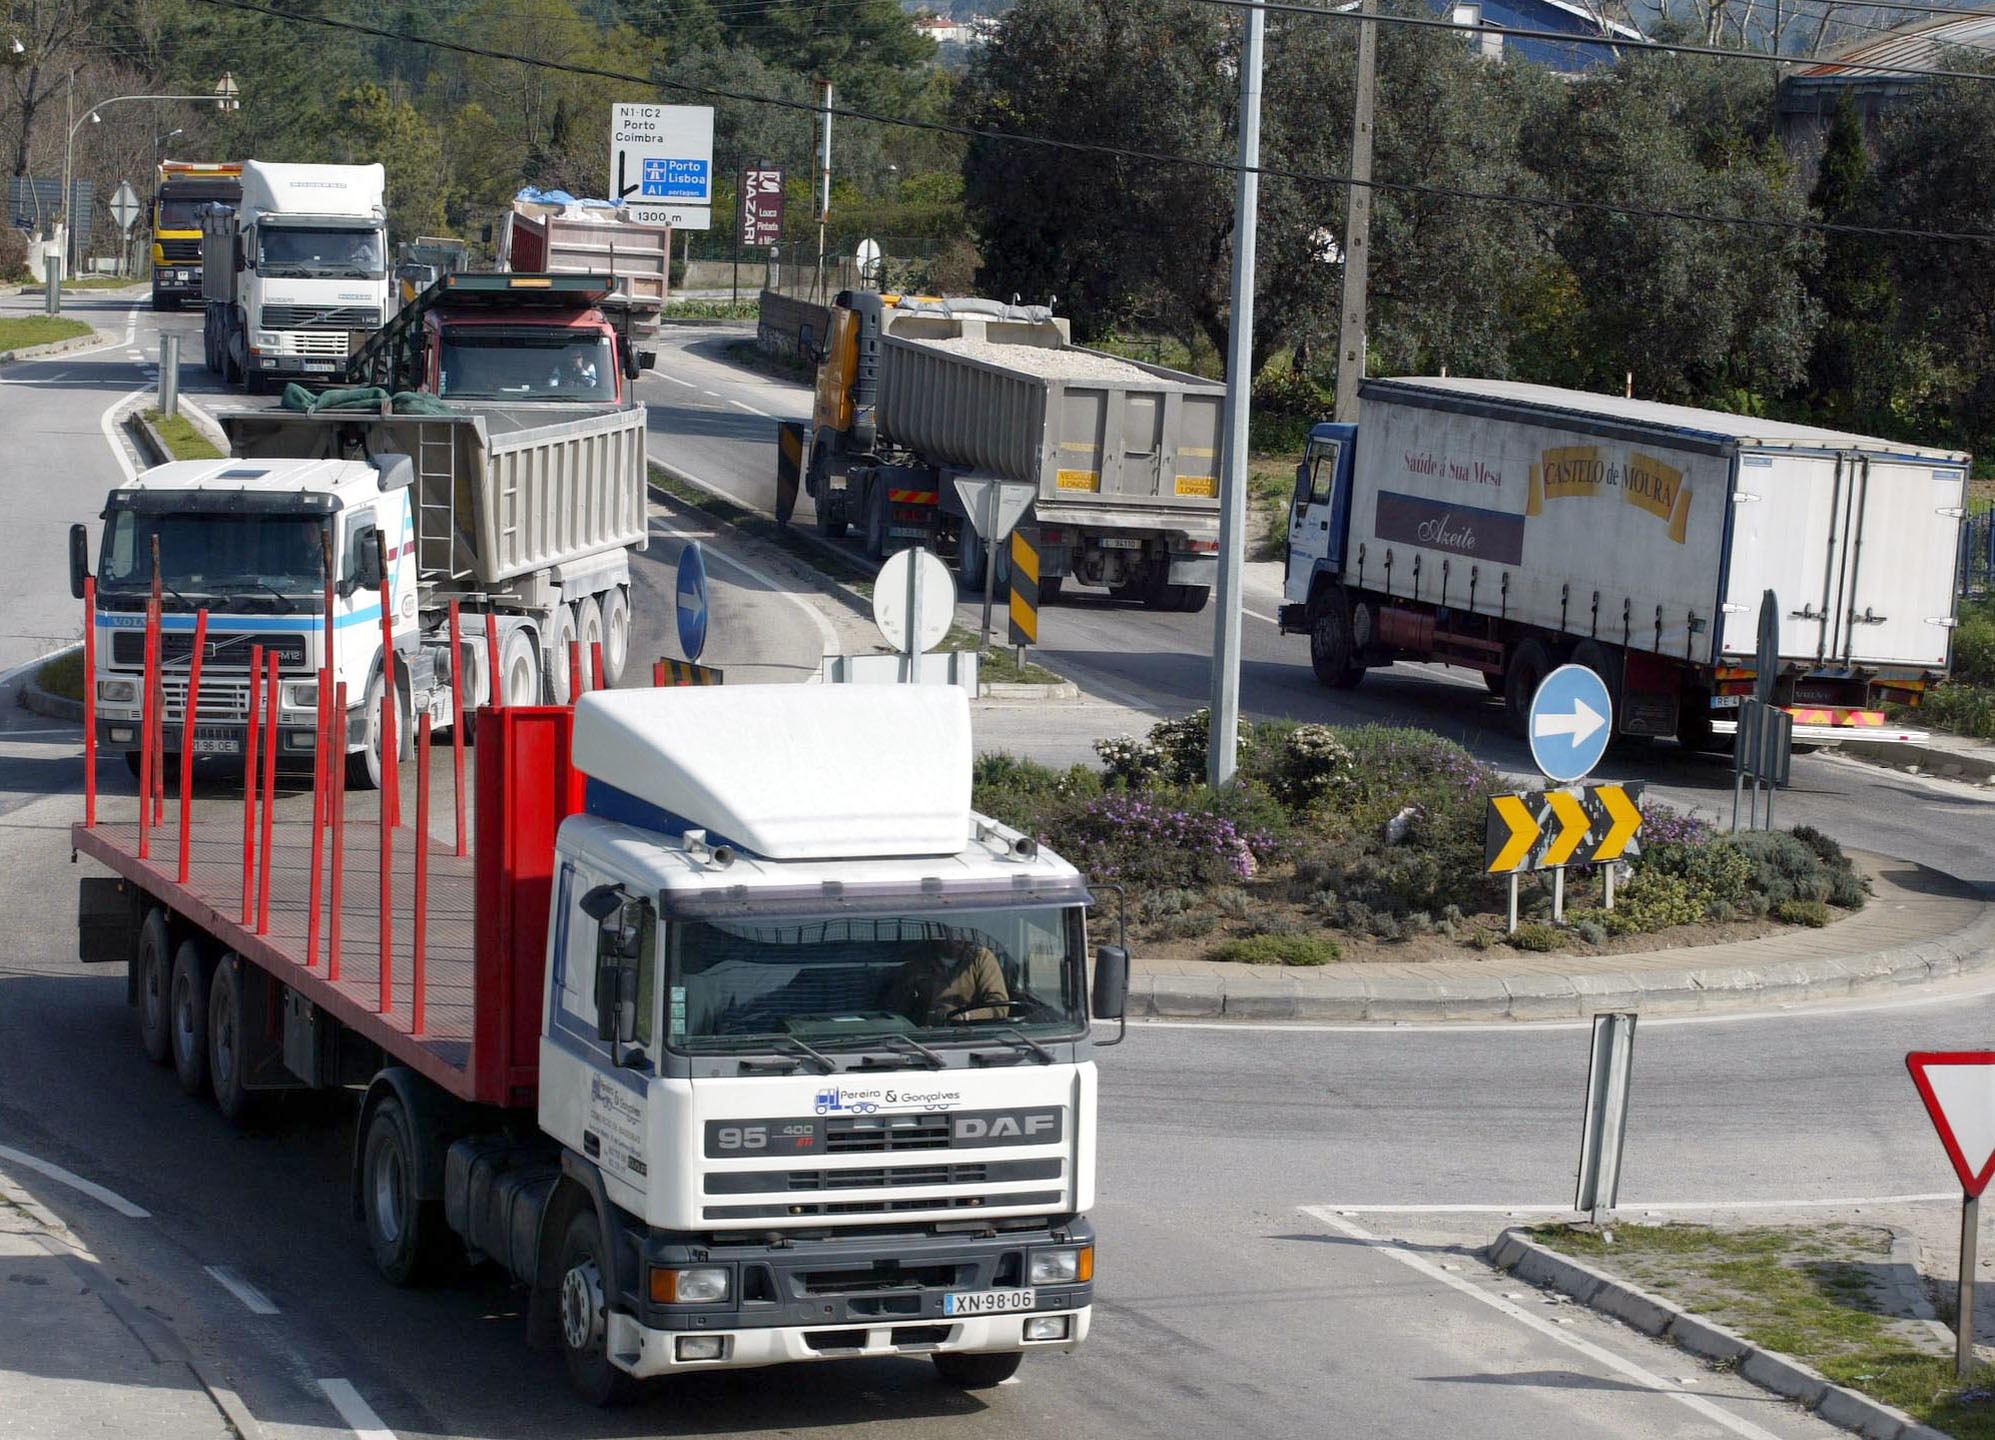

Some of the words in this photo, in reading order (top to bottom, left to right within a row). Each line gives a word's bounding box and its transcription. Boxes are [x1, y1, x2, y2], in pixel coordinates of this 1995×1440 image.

[624, 120, 656, 130] Porto
[615, 132, 664, 143] Coimbra
[669, 160, 700, 172] Porto
[668, 173, 706, 184] Lisboa
[648, 185, 662, 195] A1
[744, 171, 758, 245] NAZARI
[638, 212, 666, 221] 1300
[671, 214, 682, 222] m
[1404, 450, 1437, 475] Saúde
[1450, 462, 1469, 481] Sua
[1474, 461, 1502, 487] Mesa
[1544, 460, 1604, 485] CASTELO
[1606, 462, 1619, 485] de
[1621, 464, 1671, 507] MOURA
[1417, 514, 1476, 549] Azeite
[840, 1089, 881, 1100] Pereira
[885, 1090, 897, 1103] &
[901, 1091, 960, 1104] Gonçalves
[955, 1114, 1054, 1139] DAF
[718, 1127, 768, 1149] 95
[783, 1125, 814, 1135] 400
